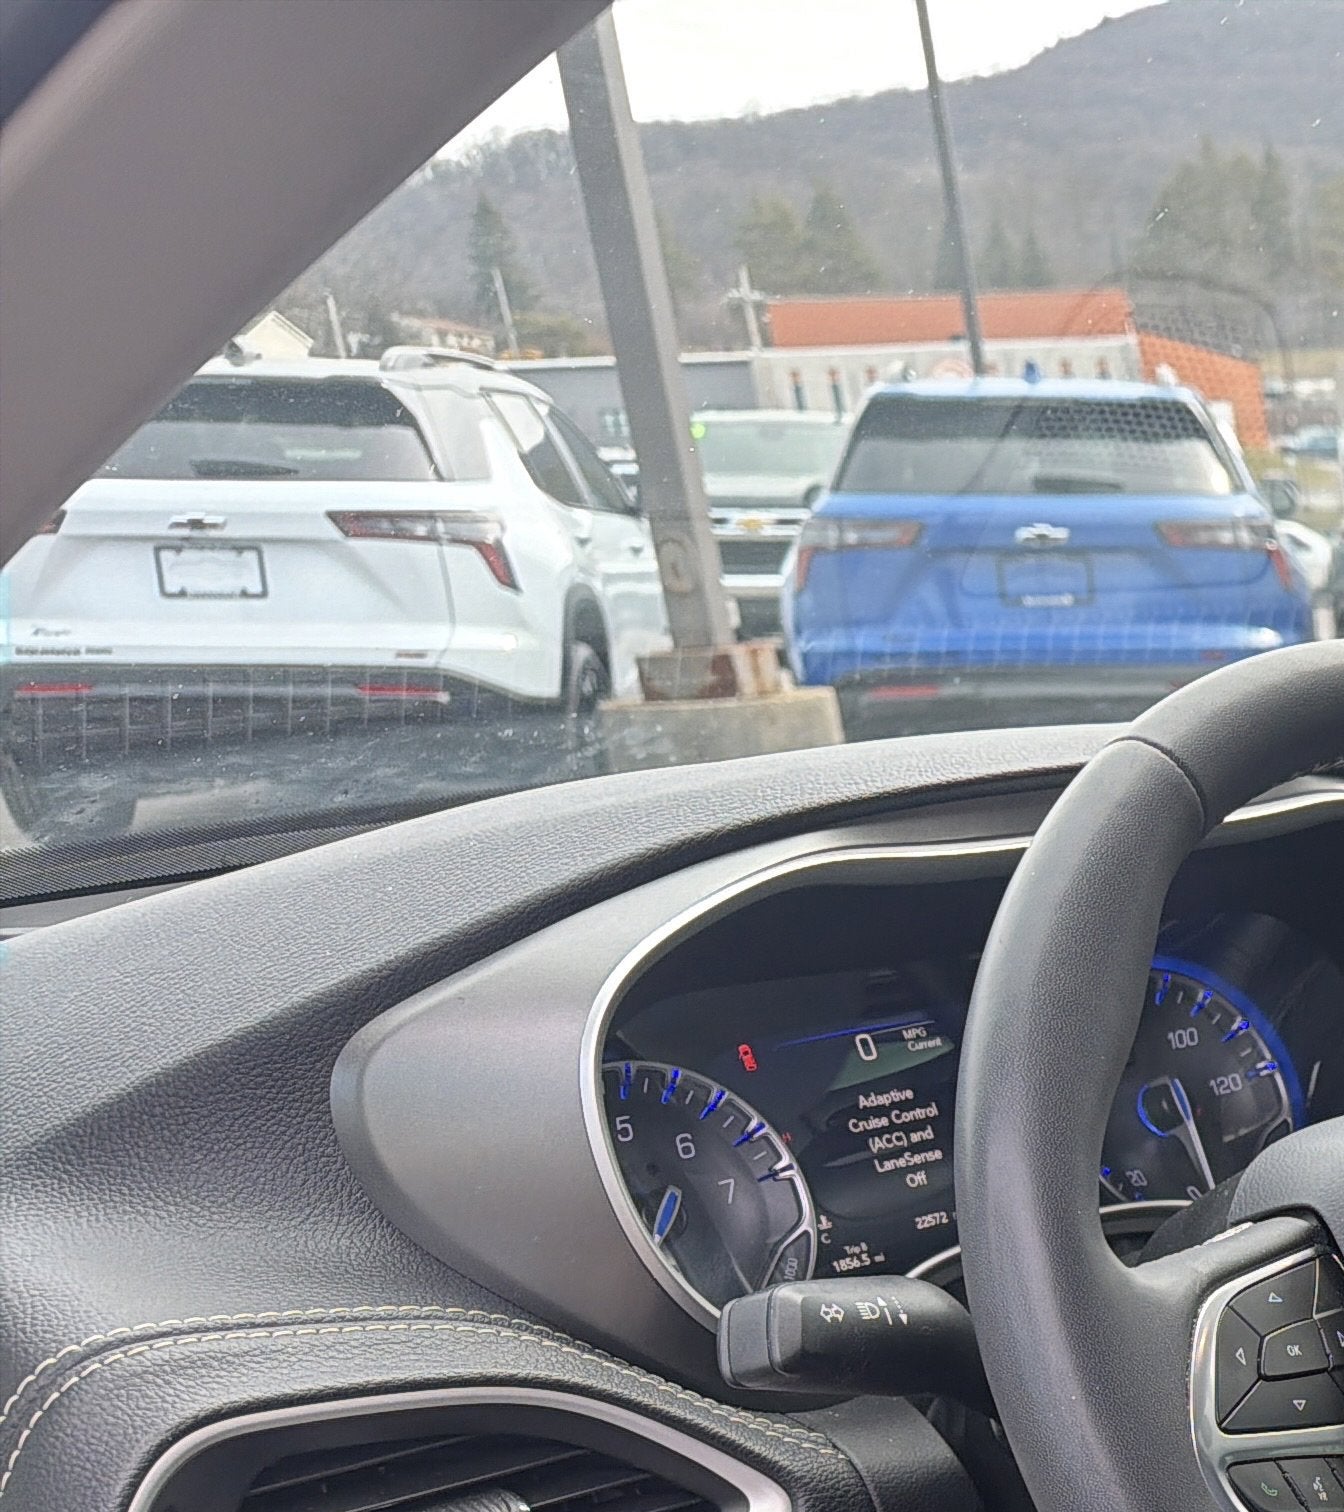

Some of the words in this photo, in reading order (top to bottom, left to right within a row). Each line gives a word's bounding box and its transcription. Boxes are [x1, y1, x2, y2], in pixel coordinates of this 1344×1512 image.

[902, 1027, 927, 1040] MPG
[907, 1037, 943, 1052] Current
[1167, 1027, 1199, 1050] 100
[855, 1033, 878, 1061] 0
[1209, 1073, 1243, 1096] 120
[858, 1088, 914, 1110] Adaptive
[615, 1114, 634, 1143] 5
[849, 1115, 889, 1133] Cruise
[891, 1102, 939, 1124] Control
[675, 1132, 696, 1160] 6
[869, 1132, 908, 1153] (ACC)
[909, 1125, 935, 1143] and
[874, 1149, 943, 1173] LaneSense
[906, 1170, 928, 1188] Off
[718, 1178, 736, 1205] 7
[914, 1211, 949, 1230] 22572
[832, 1254, 871, 1273] 1856.5
[1286, 1344, 1302, 1357] OK
